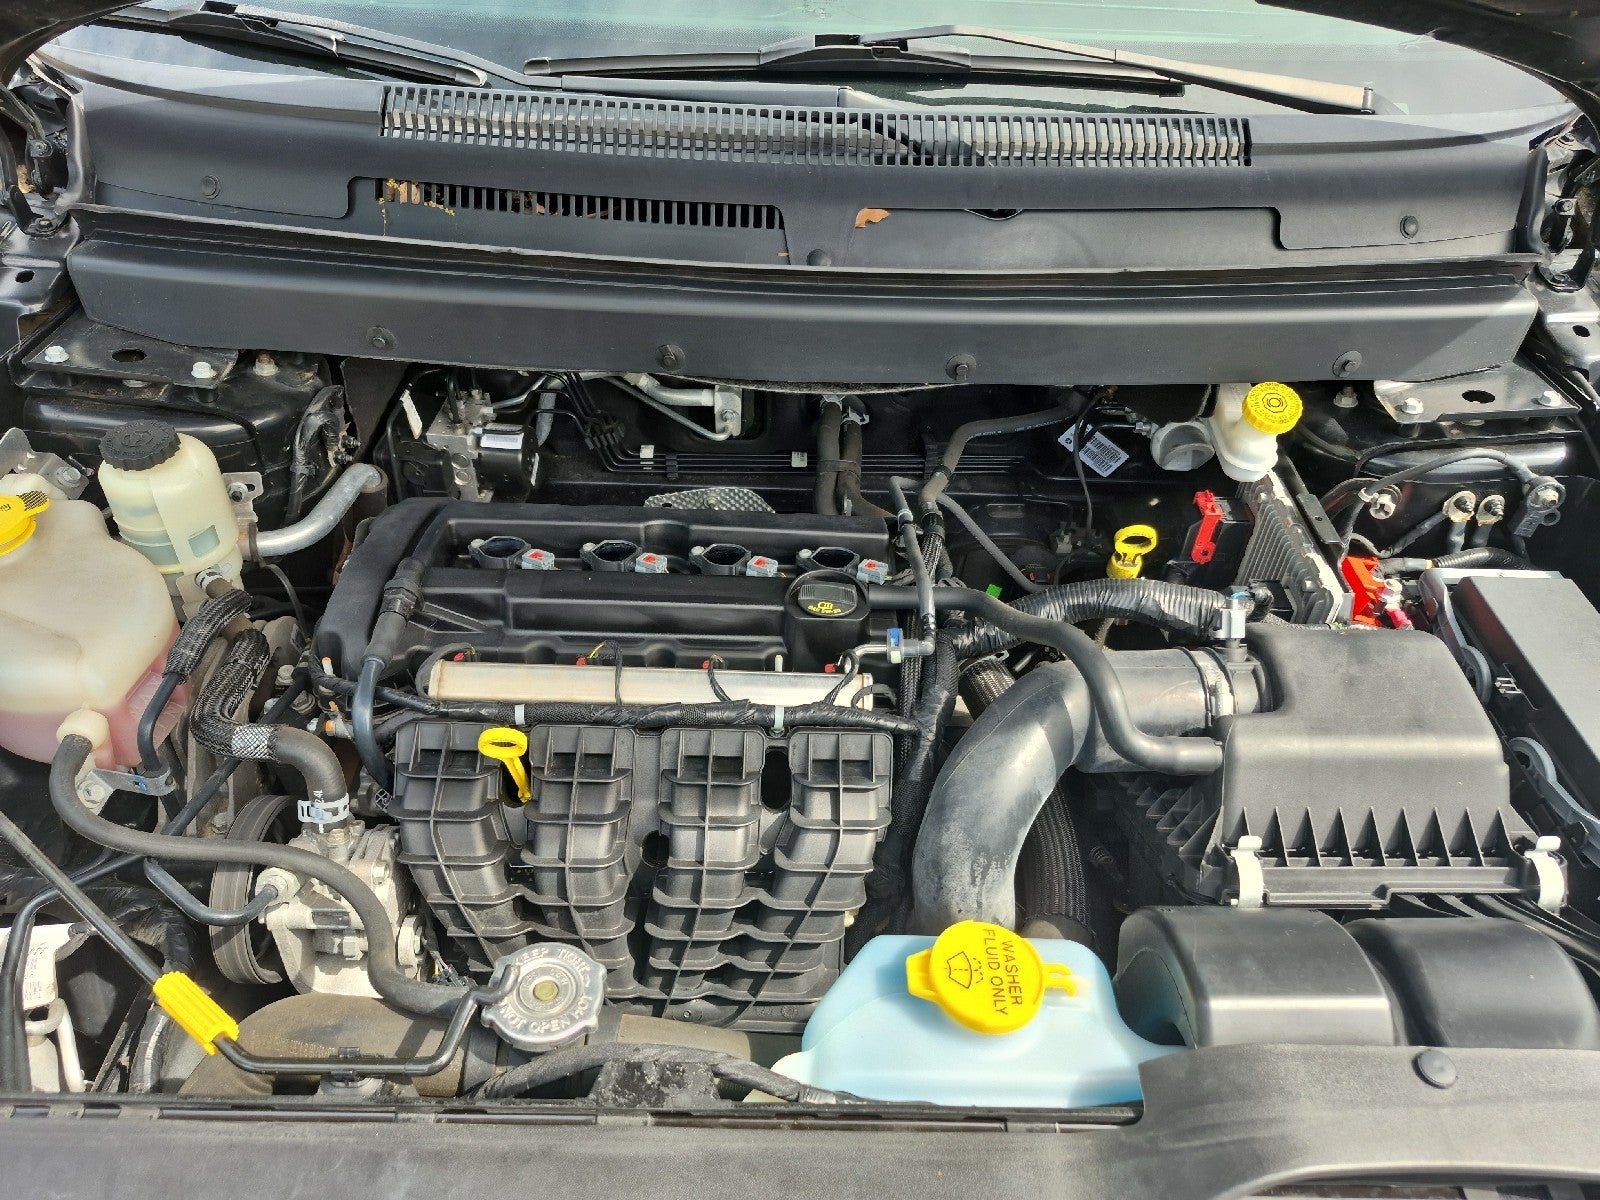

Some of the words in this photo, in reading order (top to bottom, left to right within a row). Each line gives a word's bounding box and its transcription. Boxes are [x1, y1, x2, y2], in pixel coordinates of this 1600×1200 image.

[515, 947, 549, 966] KEEP
[558, 948, 591, 972] TIGHT
[983, 928, 1000, 970] FLUID
[1002, 940, 1023, 1005] WASHER
[499, 1006, 527, 1029] NOT
[531, 1017, 570, 1034] OPEN
[571, 993, 593, 1019] HOT
[990, 976, 1008, 1016] ONLY
